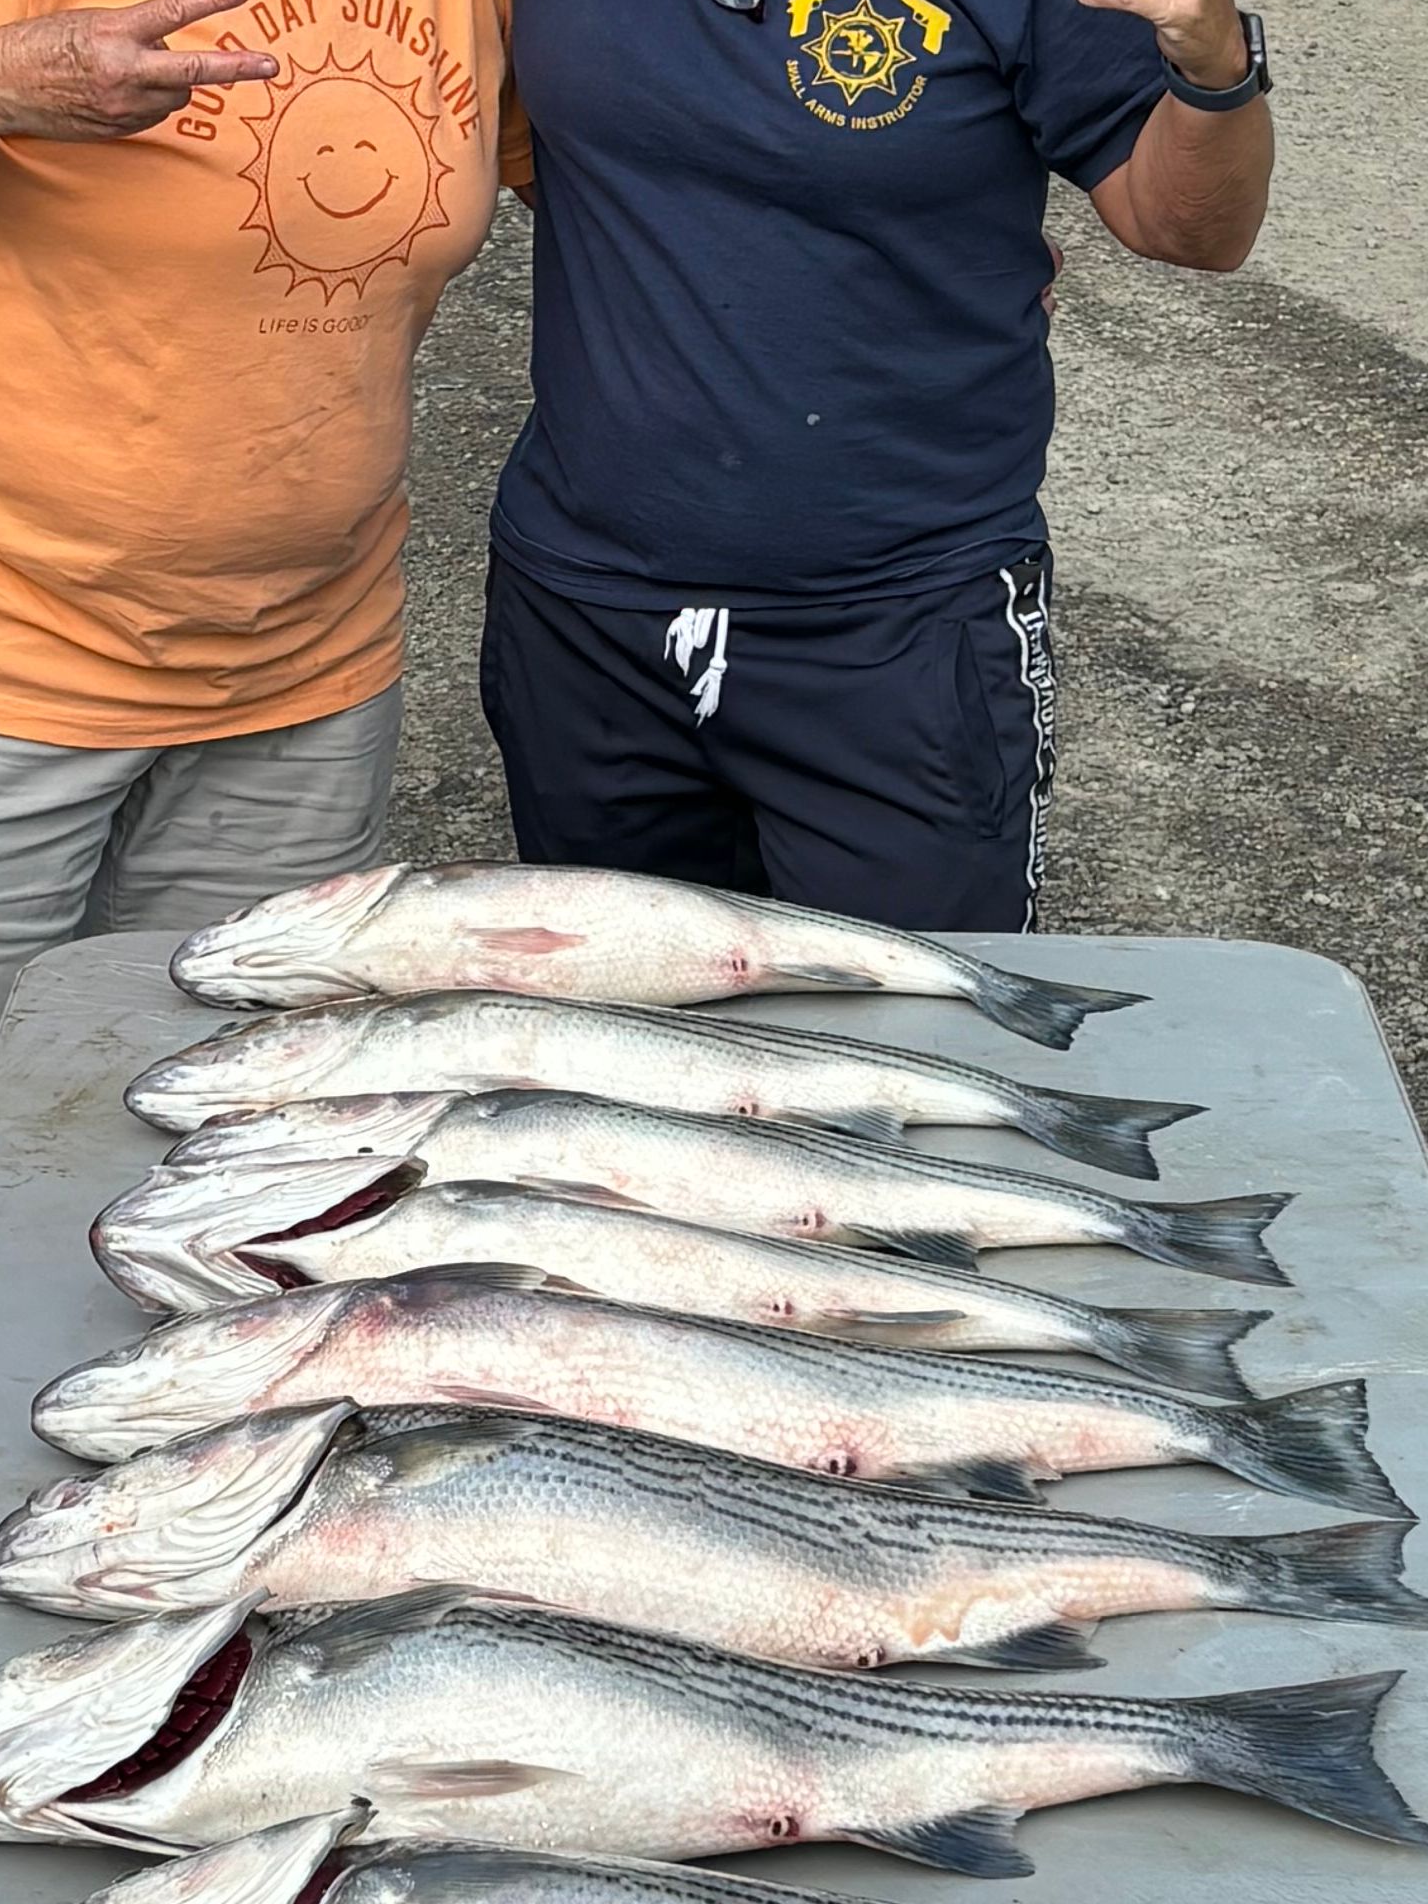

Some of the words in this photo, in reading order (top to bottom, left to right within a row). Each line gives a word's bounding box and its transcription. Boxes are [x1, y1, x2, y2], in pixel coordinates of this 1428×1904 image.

[786, 58, 807, 99] SMALL
[805, 99, 846, 127] ARMS
[851, 75, 928, 130] INSTRUCTOR
